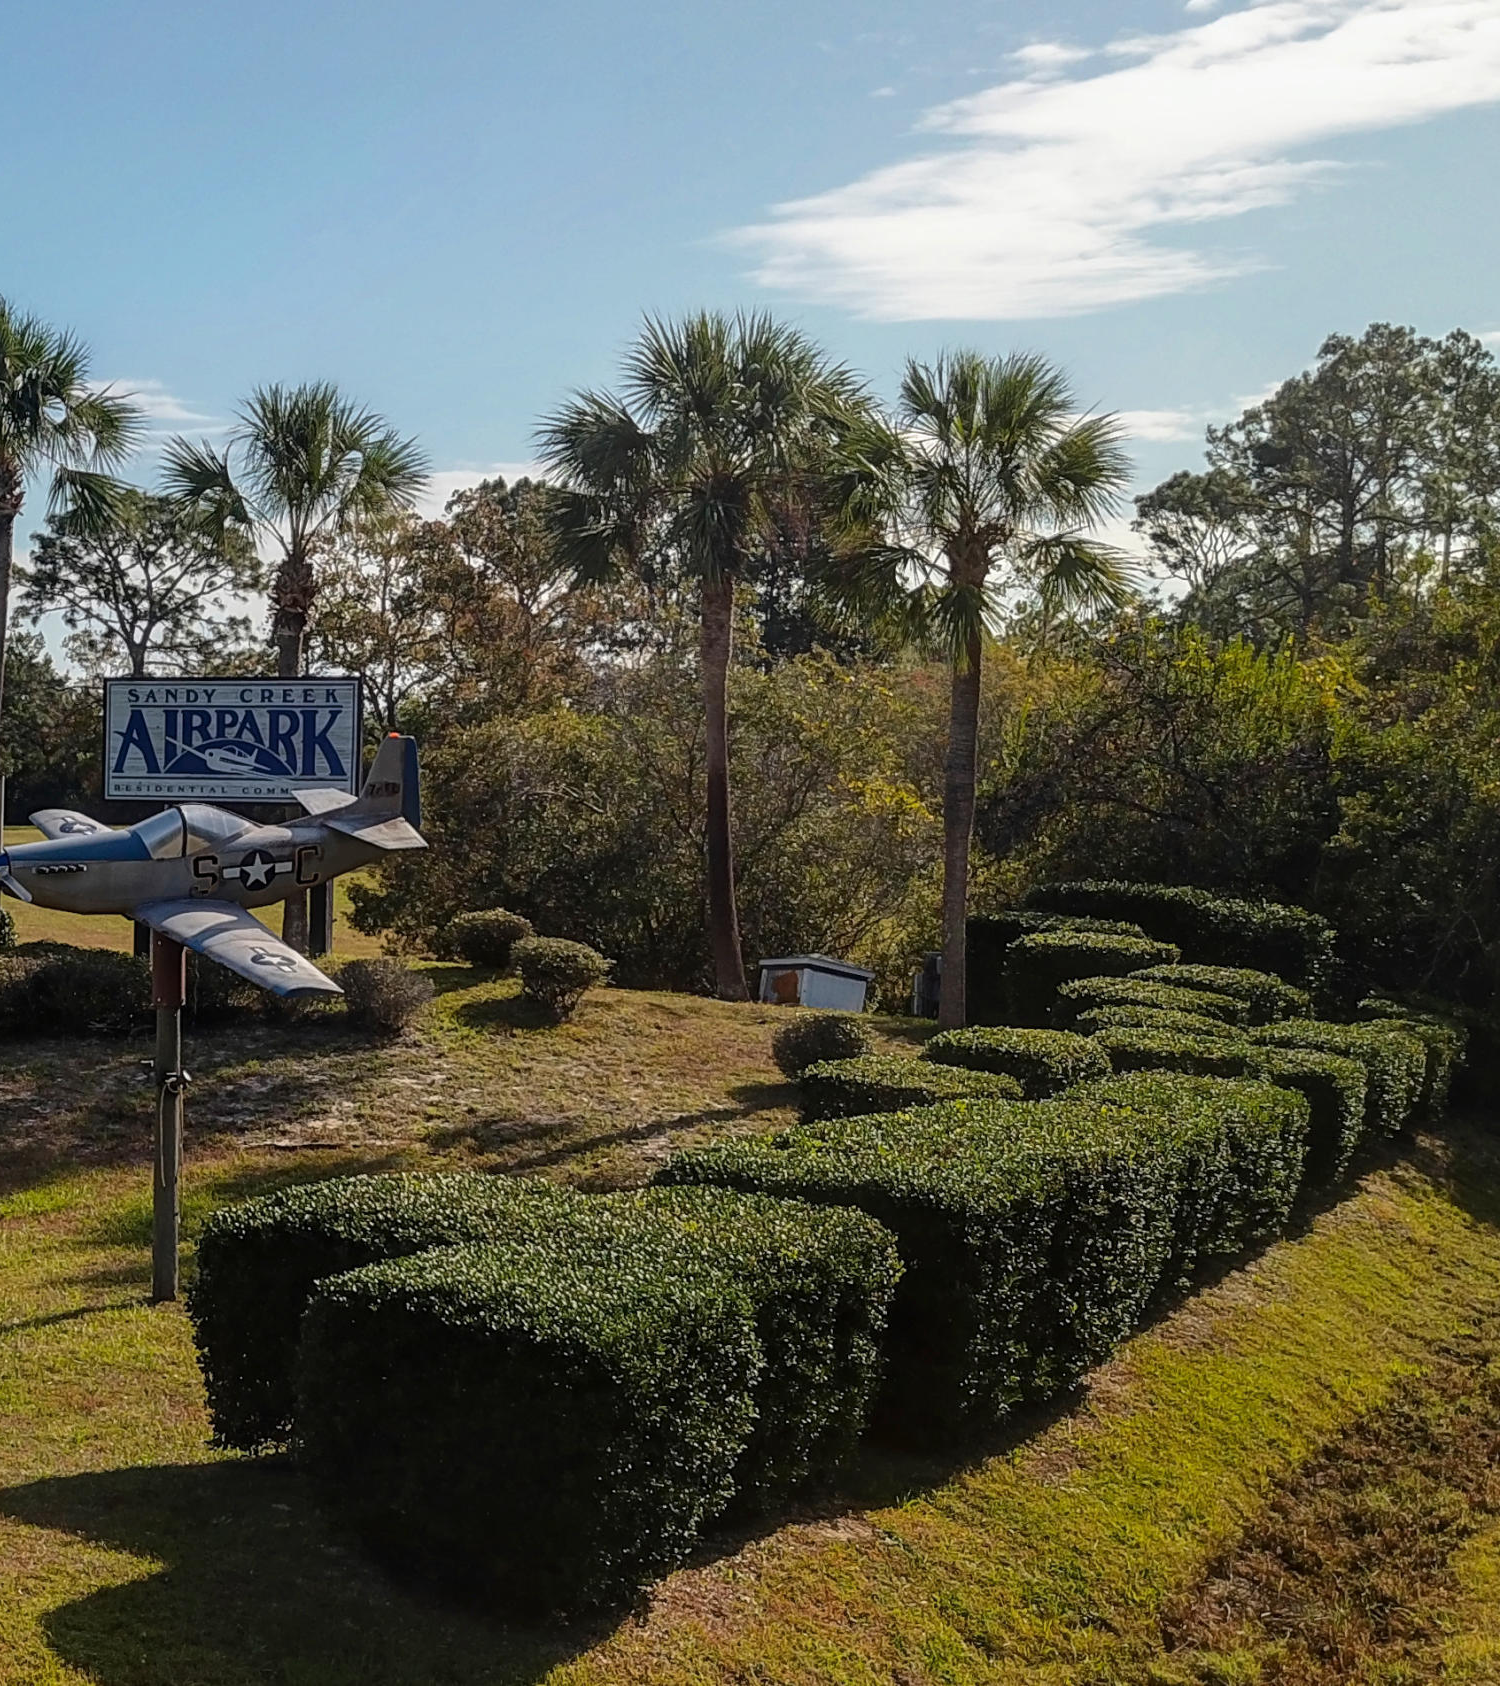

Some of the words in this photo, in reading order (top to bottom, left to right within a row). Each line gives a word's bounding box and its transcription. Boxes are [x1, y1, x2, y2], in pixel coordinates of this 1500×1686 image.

[127, 688, 217, 703] SANDY
[239, 688, 339, 703] CREEK
[112, 709, 348, 777] AIRPARK
[114, 783, 228, 794] RESIDENTIAL
[192, 854, 219, 894] S
[296, 845, 319, 885] C
